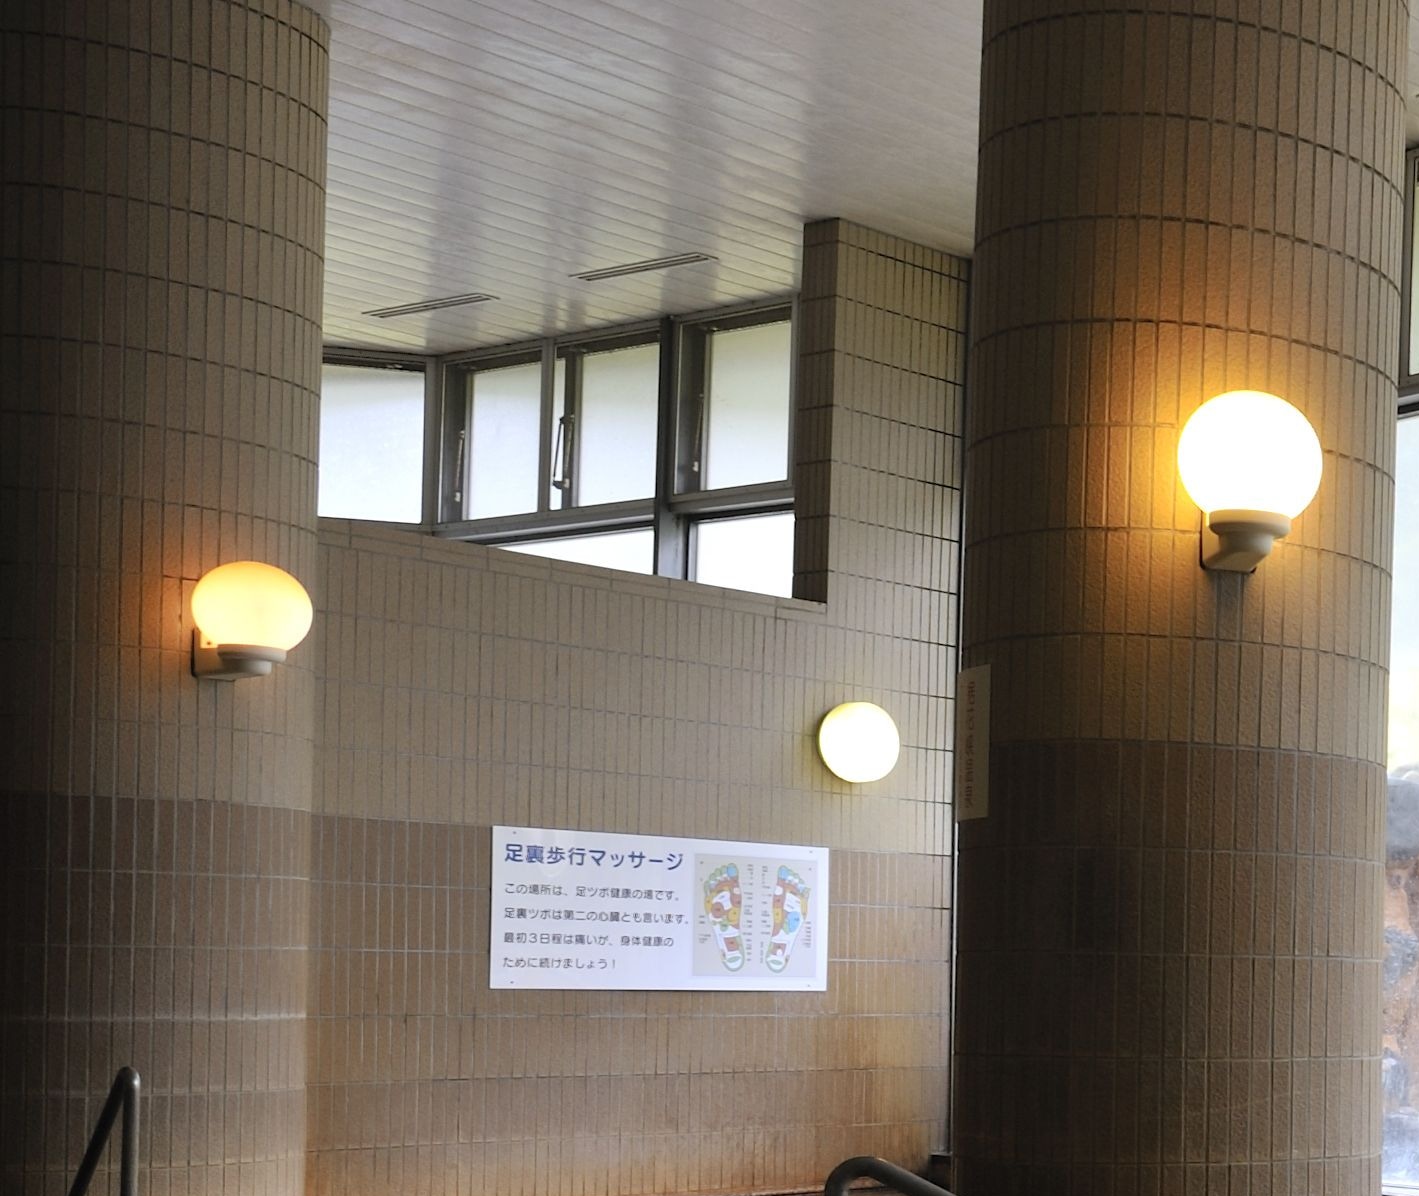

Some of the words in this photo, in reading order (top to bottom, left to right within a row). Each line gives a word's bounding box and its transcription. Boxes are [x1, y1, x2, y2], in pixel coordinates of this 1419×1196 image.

[504, 843, 684, 871] 足裏歩行マッサージ
